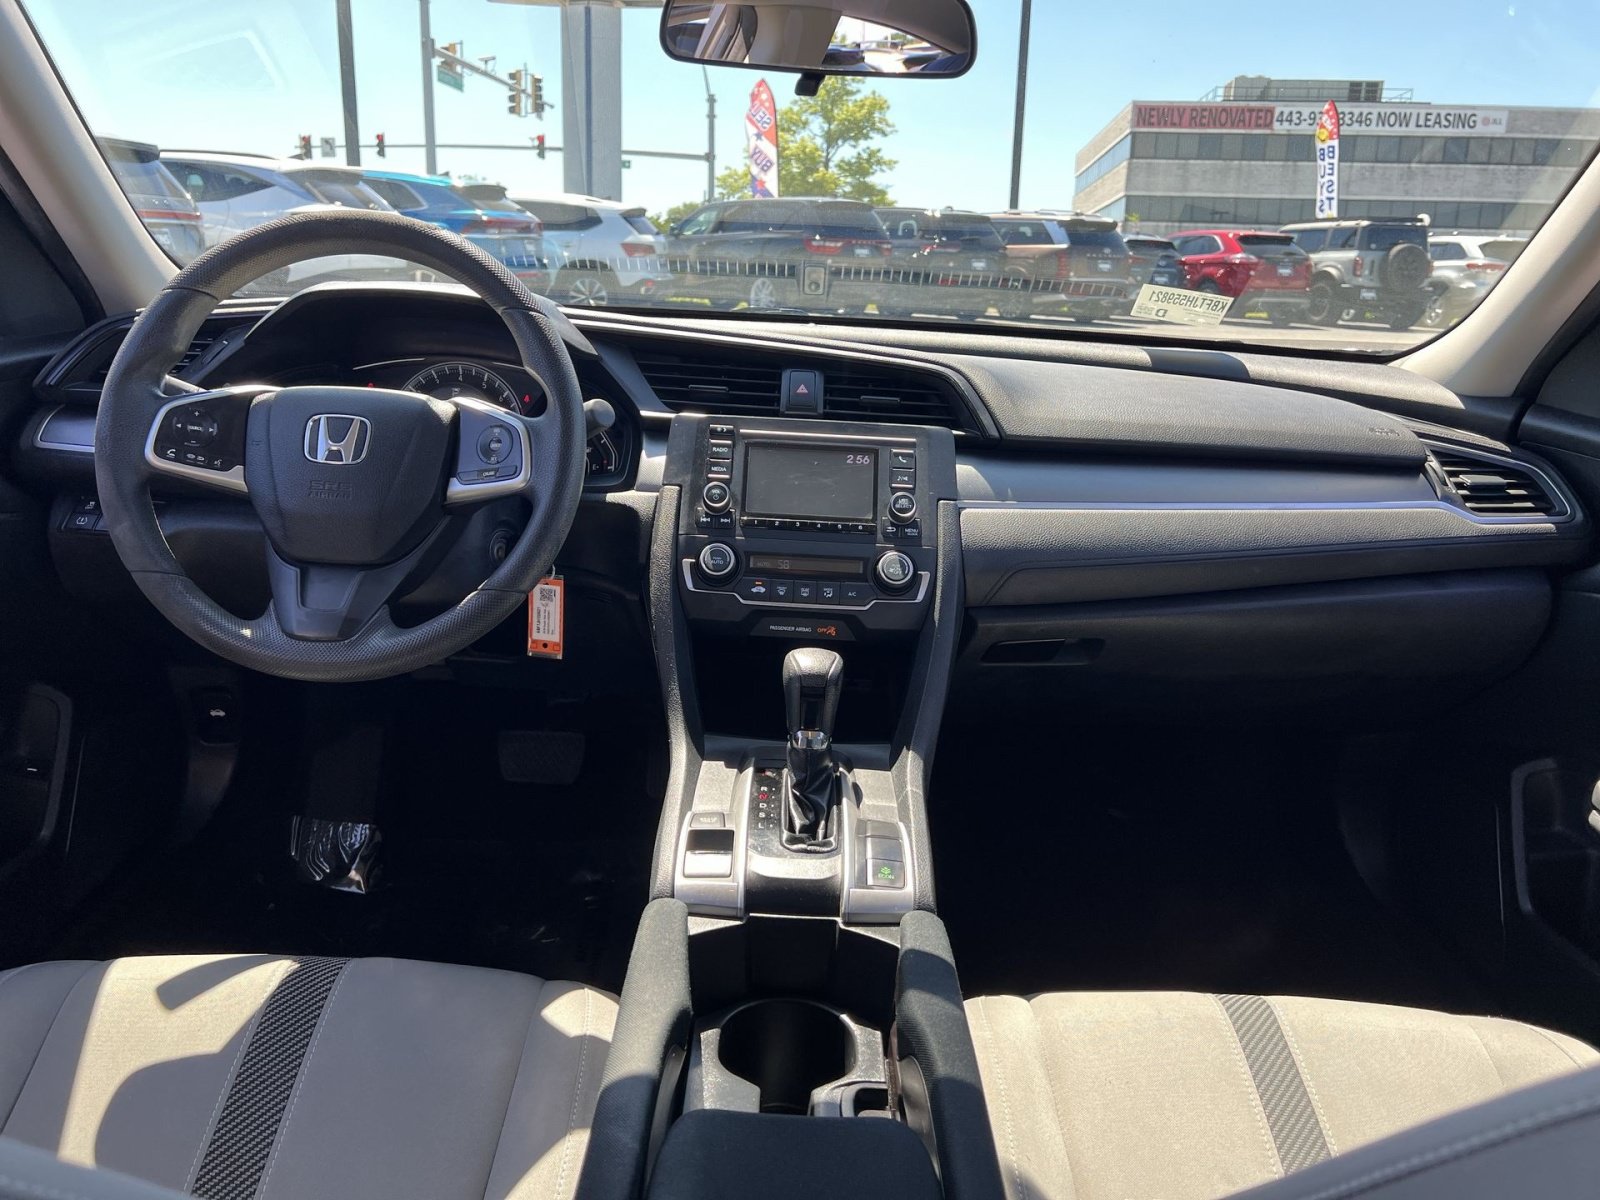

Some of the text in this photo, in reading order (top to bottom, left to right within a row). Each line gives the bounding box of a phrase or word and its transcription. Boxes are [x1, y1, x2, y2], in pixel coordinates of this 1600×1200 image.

[1136, 106, 1186, 128] NEWLY
[1188, 106, 1274, 129] RENOVATED
[1375, 111, 1411, 128] NOW
[1415, 112, 1477, 129] LEASING
